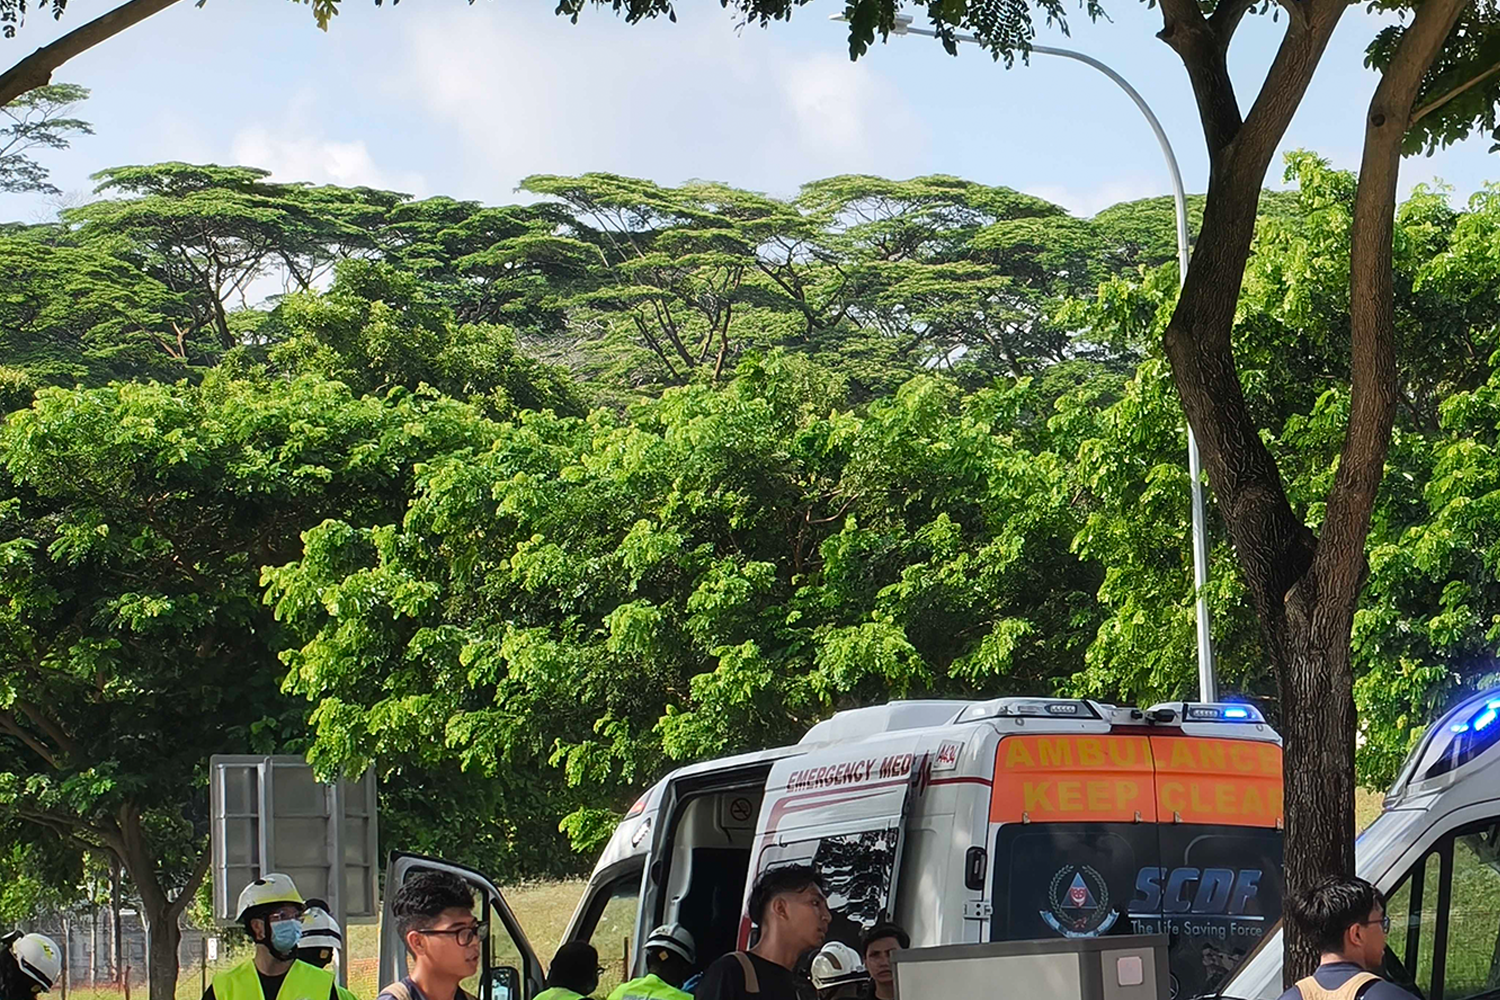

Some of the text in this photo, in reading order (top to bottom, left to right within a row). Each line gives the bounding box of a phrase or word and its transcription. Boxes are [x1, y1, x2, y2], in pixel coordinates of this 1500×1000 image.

[1004, 738, 1281, 774] AMBULANCE
[786, 758, 876, 793] EMERGENCY
[1023, 781, 1139, 812] KEEP
[1128, 867, 1263, 915] SCDF
[1131, 920, 1154, 934] The
[1158, 920, 1179, 935] Life
[1185, 921, 1226, 940] Saving
[1231, 922, 1263, 937] Force
